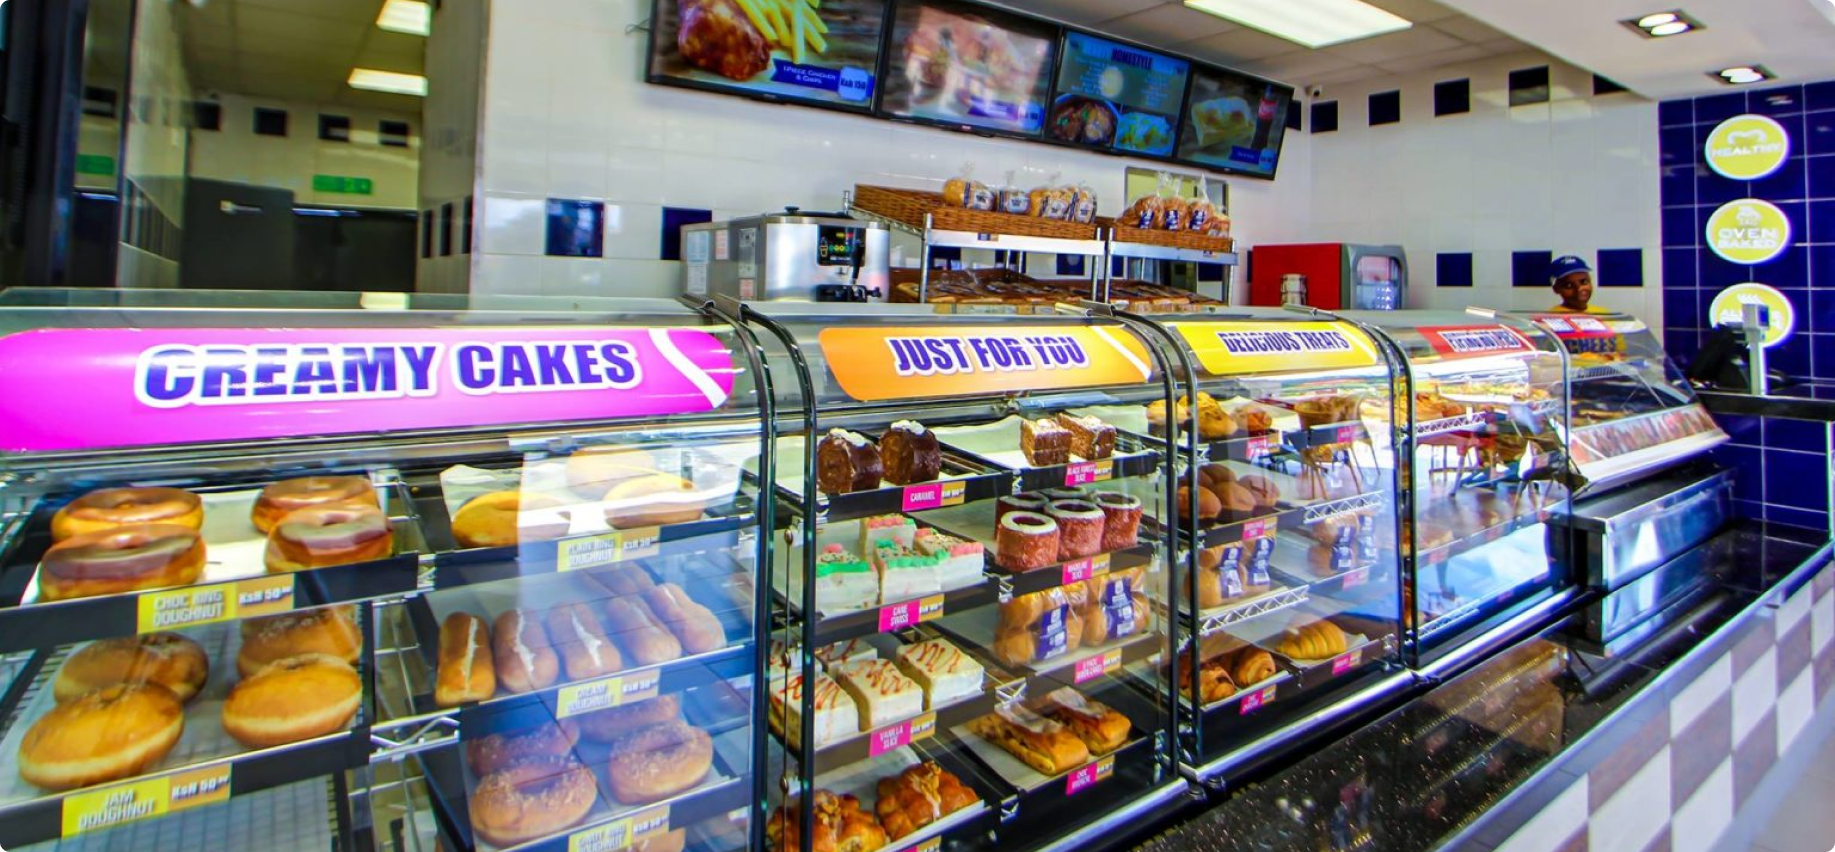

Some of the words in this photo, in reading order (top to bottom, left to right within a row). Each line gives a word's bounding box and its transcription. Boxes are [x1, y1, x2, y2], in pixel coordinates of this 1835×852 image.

[1712, 142, 1781, 157] HEALTHY
[1718, 228, 1778, 240] OVEN
[1718, 239, 1778, 250] BAKED
[1217, 331, 1300, 353] DELICIOUS
[1294, 331, 1349, 350] TREATS
[889, 338, 969, 371] JUST
[970, 338, 1032, 367] FOR
[1025, 336, 1087, 365] YOU
[144, 345, 437, 401] CREAMY
[457, 343, 636, 390] CAKES
[910, 491, 936, 502] CARAMEL
[570, 549, 613, 565] DOUGHNUT
[153, 595, 189, 611] CHOC
[193, 590, 224, 605] RING
[153, 602, 224, 628] DOUGHNUT
[568, 694, 613, 712] DOUGHNUT
[879, 724, 903, 740] VANILLA
[105, 789, 134, 808] JAM
[79, 799, 154, 829] DOUGHNUT
